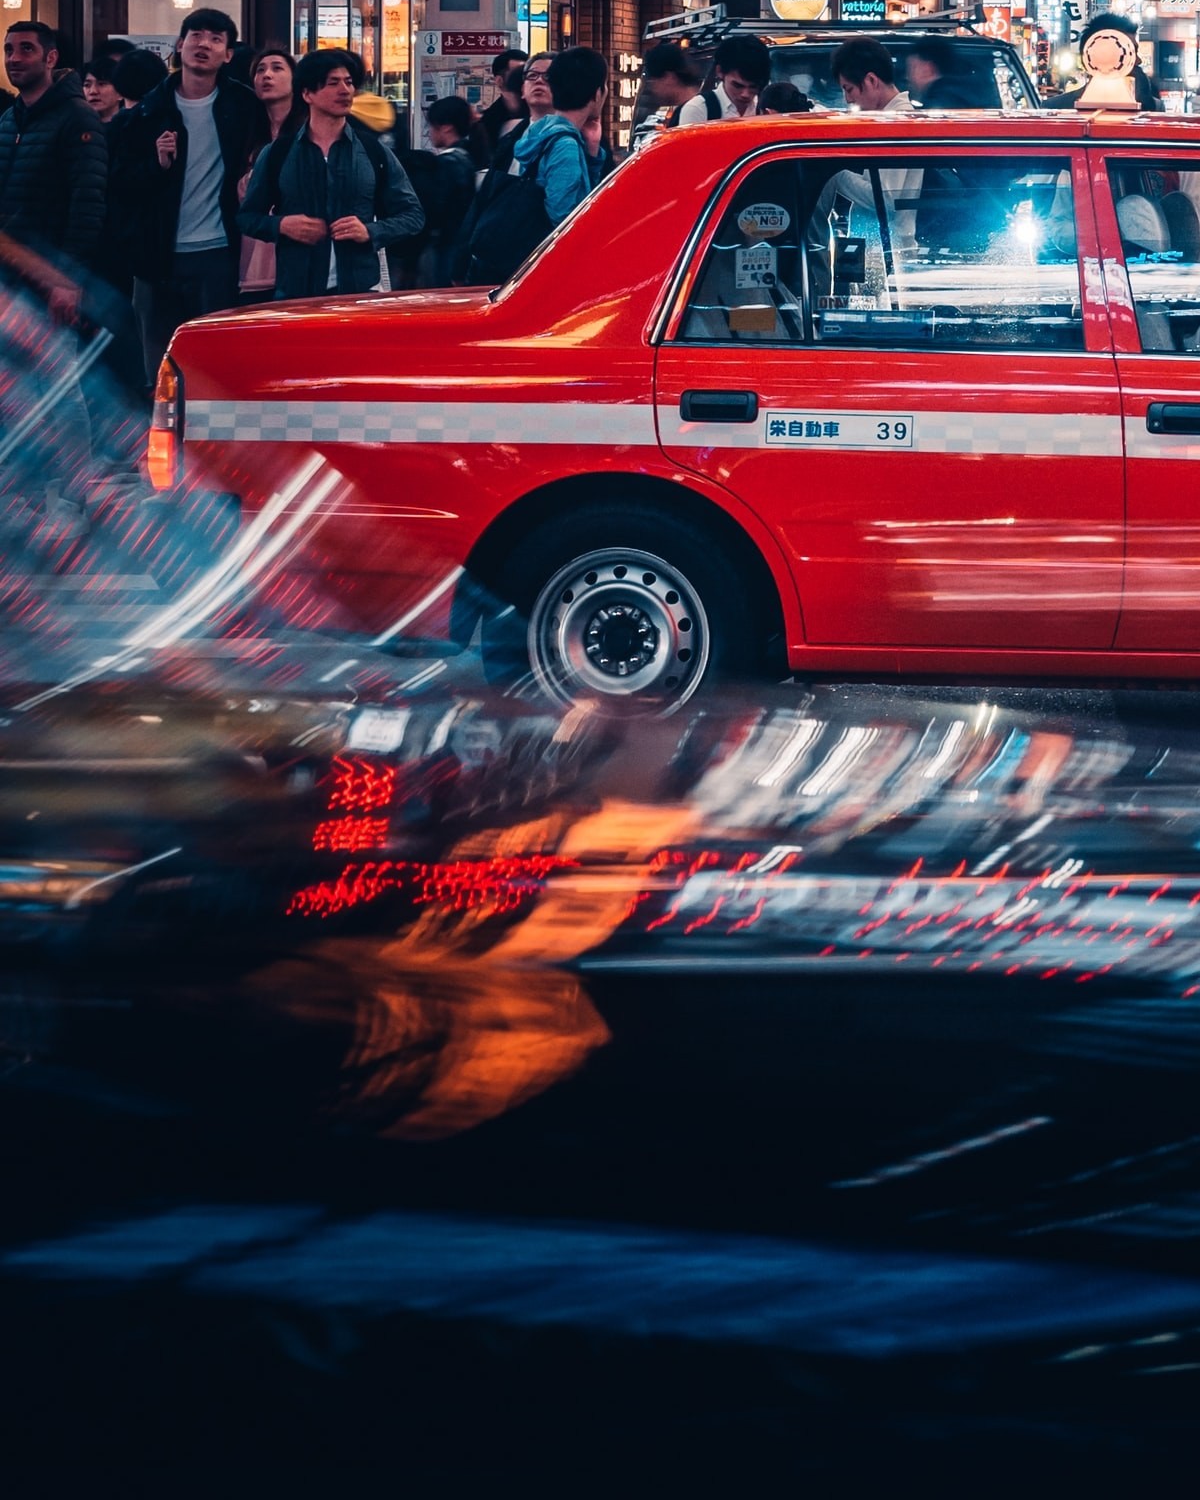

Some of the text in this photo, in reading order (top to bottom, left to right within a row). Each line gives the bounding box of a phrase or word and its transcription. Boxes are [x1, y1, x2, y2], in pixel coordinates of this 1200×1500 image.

[769, 419, 908, 441] 栄自動車 39
